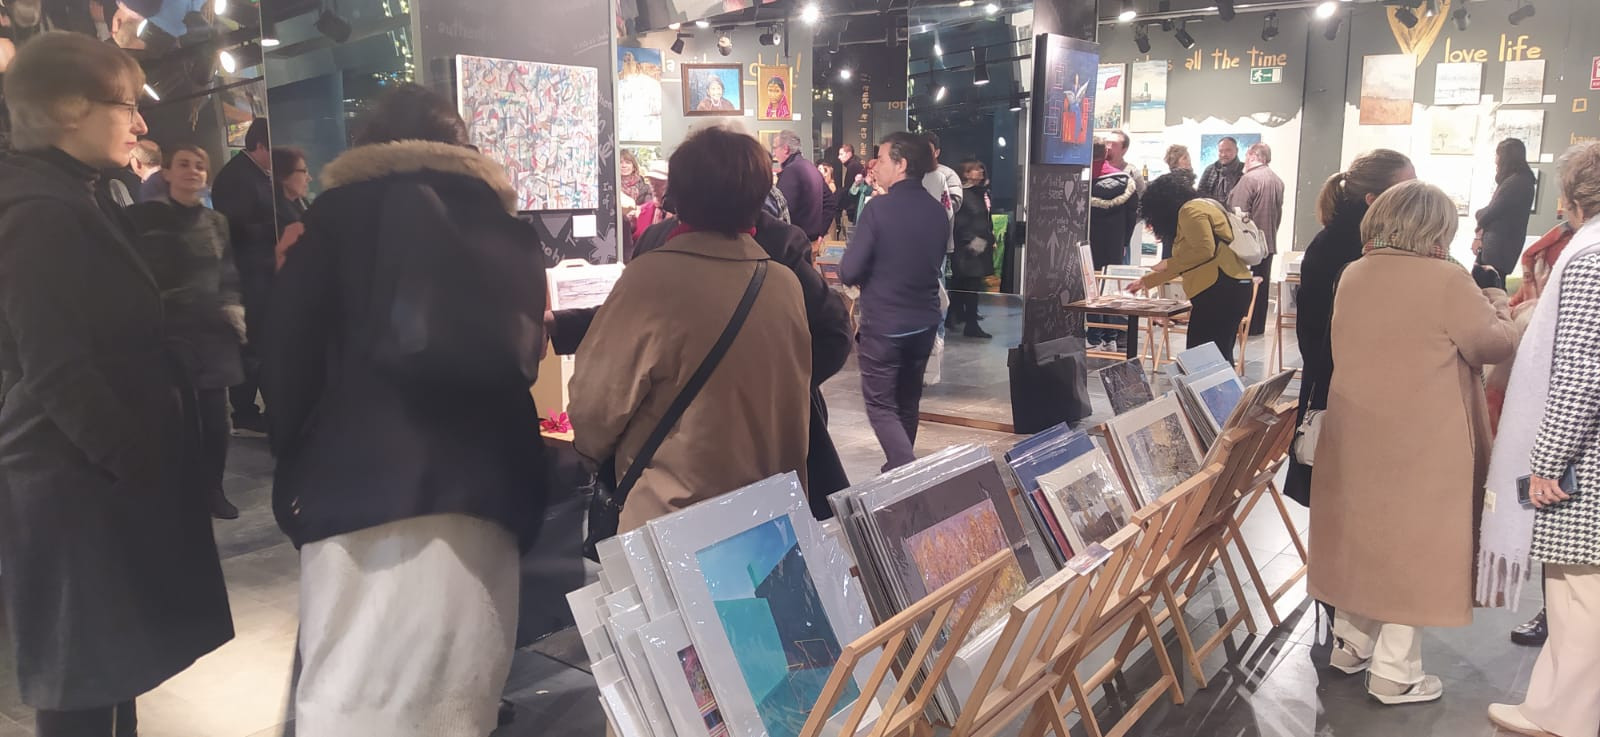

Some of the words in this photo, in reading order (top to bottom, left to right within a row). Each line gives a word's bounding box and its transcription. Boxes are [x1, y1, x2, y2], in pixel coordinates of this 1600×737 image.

[1185, 49, 1202, 71] all
[1211, 47, 1240, 71] the
[1247, 45, 1288, 67] time
[1444, 37, 1488, 64] love
[1498, 33, 1542, 62] life
